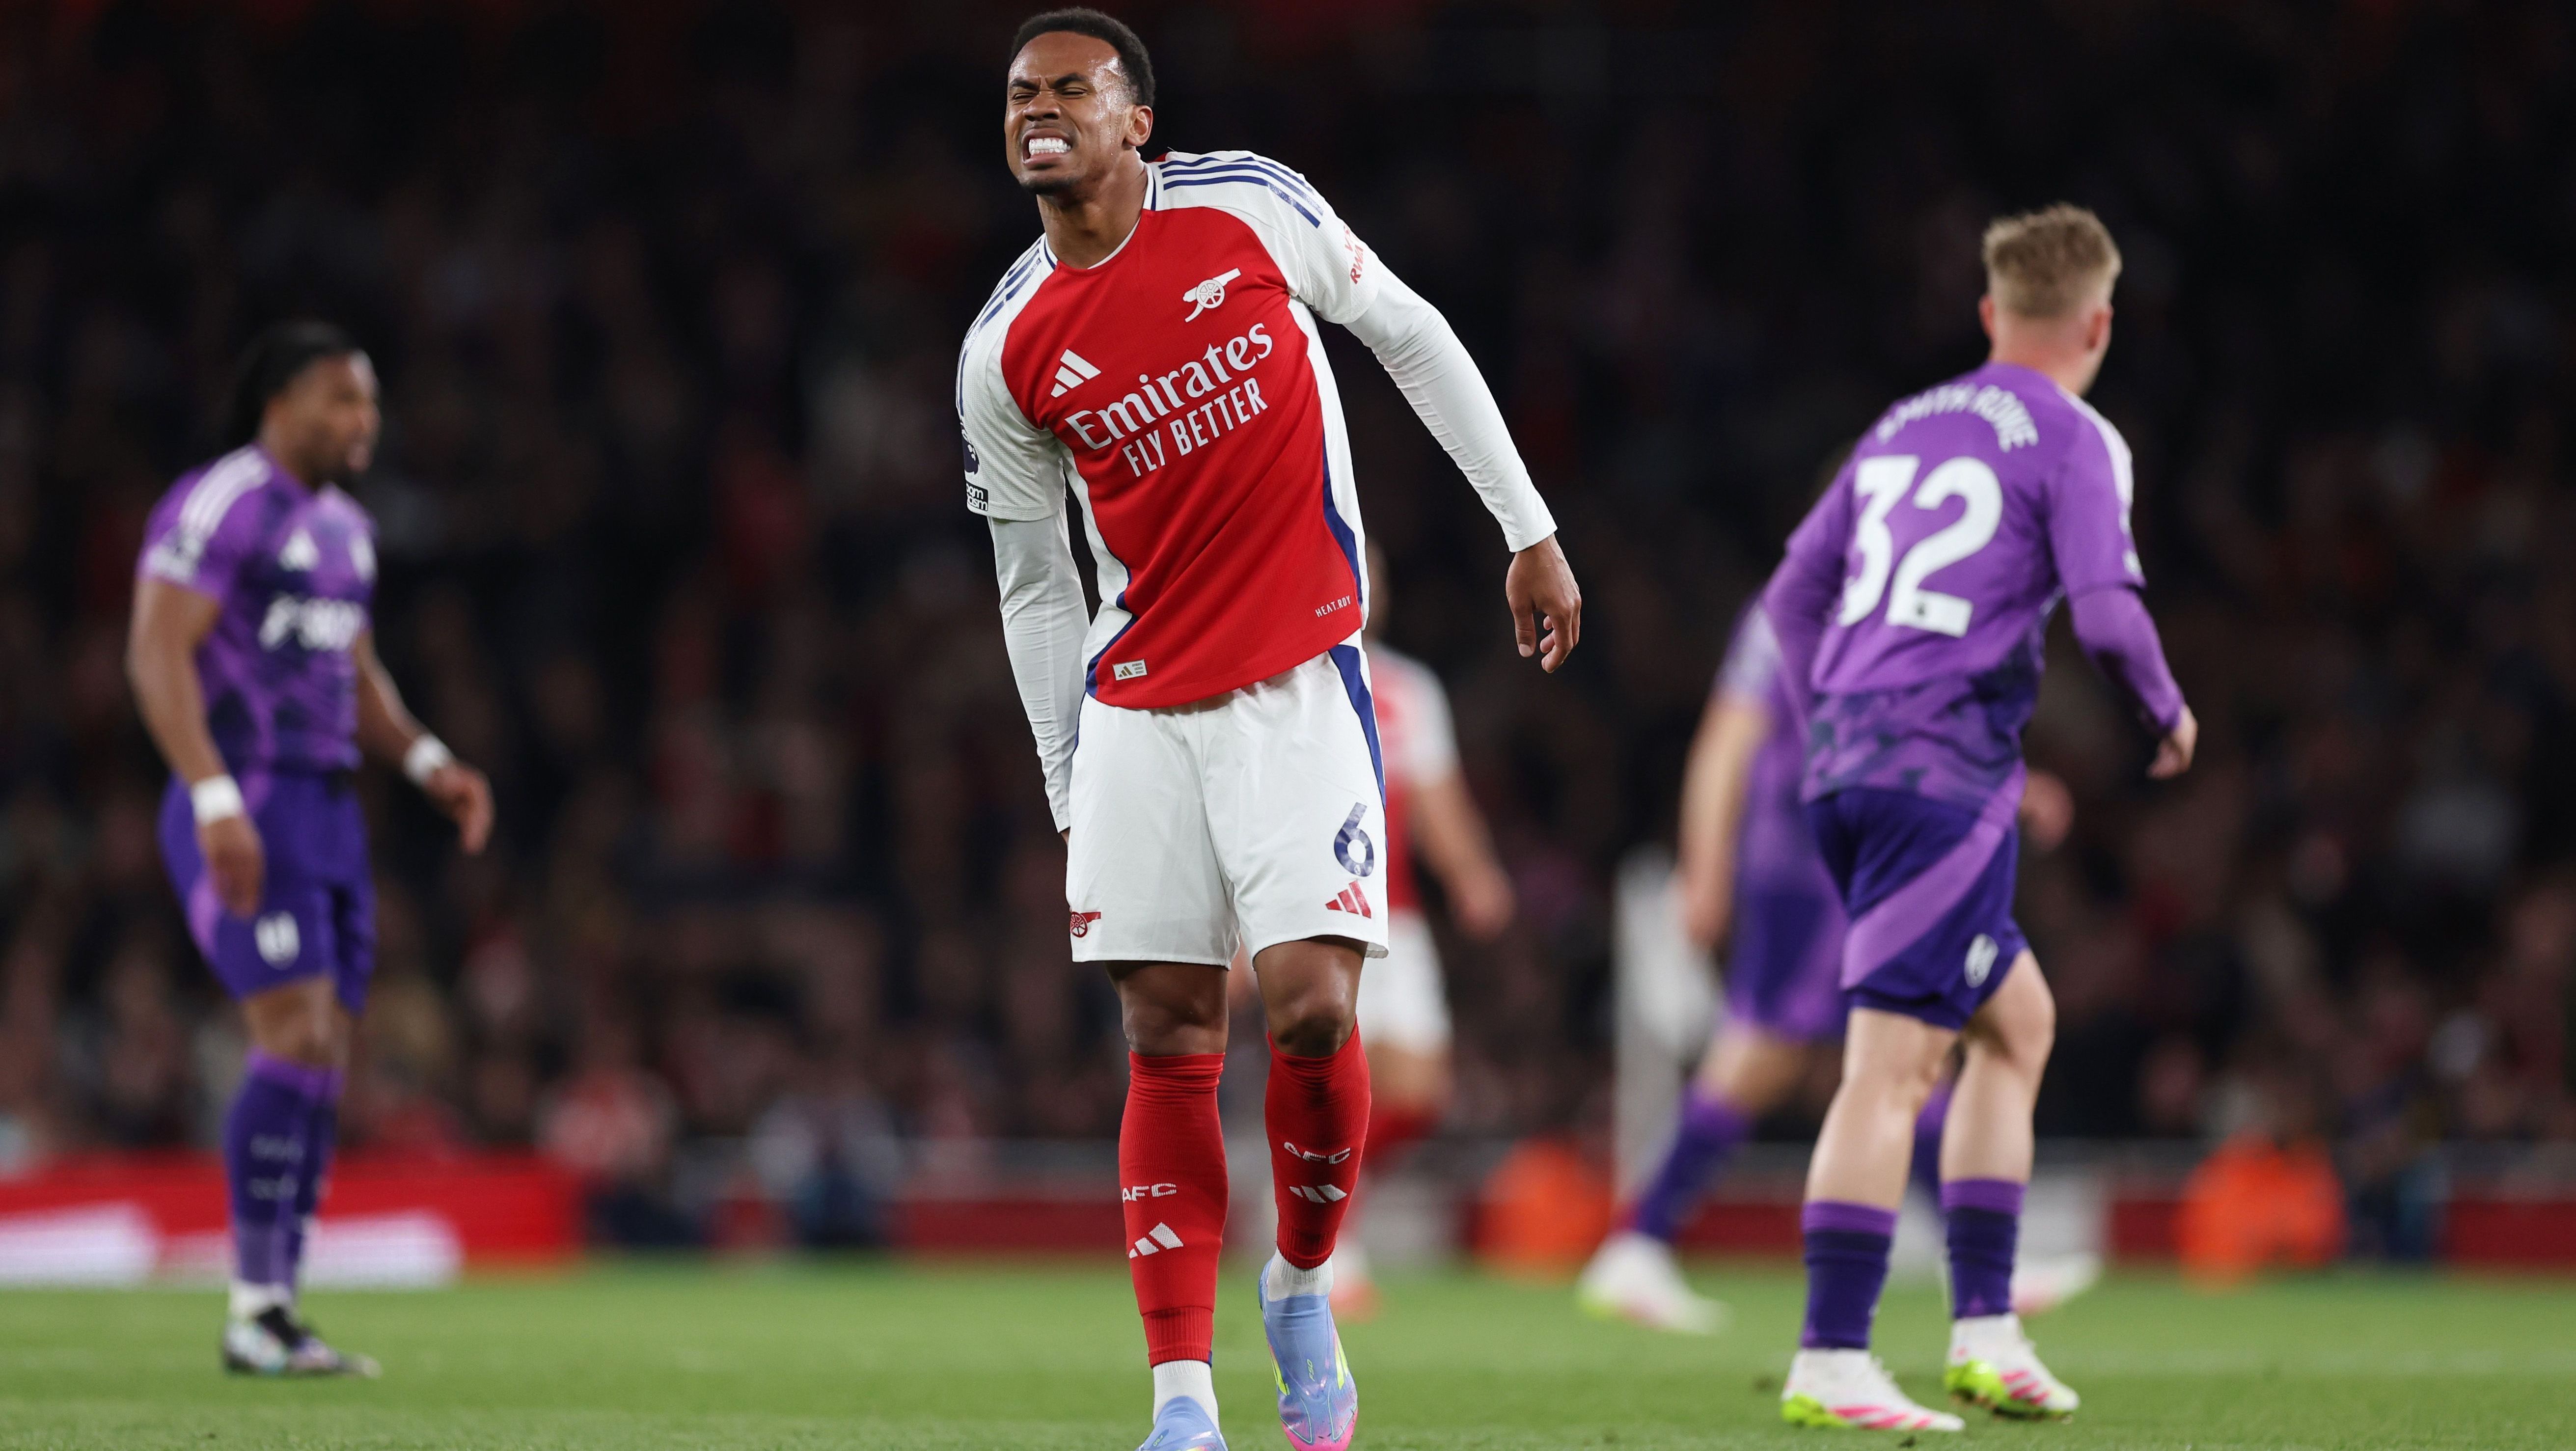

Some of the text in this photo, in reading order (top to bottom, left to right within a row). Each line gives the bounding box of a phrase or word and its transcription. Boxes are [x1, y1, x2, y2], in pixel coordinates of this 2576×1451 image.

[1065, 323, 1272, 450] Emirates
[1123, 377, 1268, 477] FLY BETTER
[1838, 454, 2003, 637] 32
[1315, 595, 1351, 617] HEAT.RDY
[1334, 802, 1374, 877] 6
[1282, 1142, 1351, 1164] AFC
[1122, 1183, 1177, 1204] AFC
